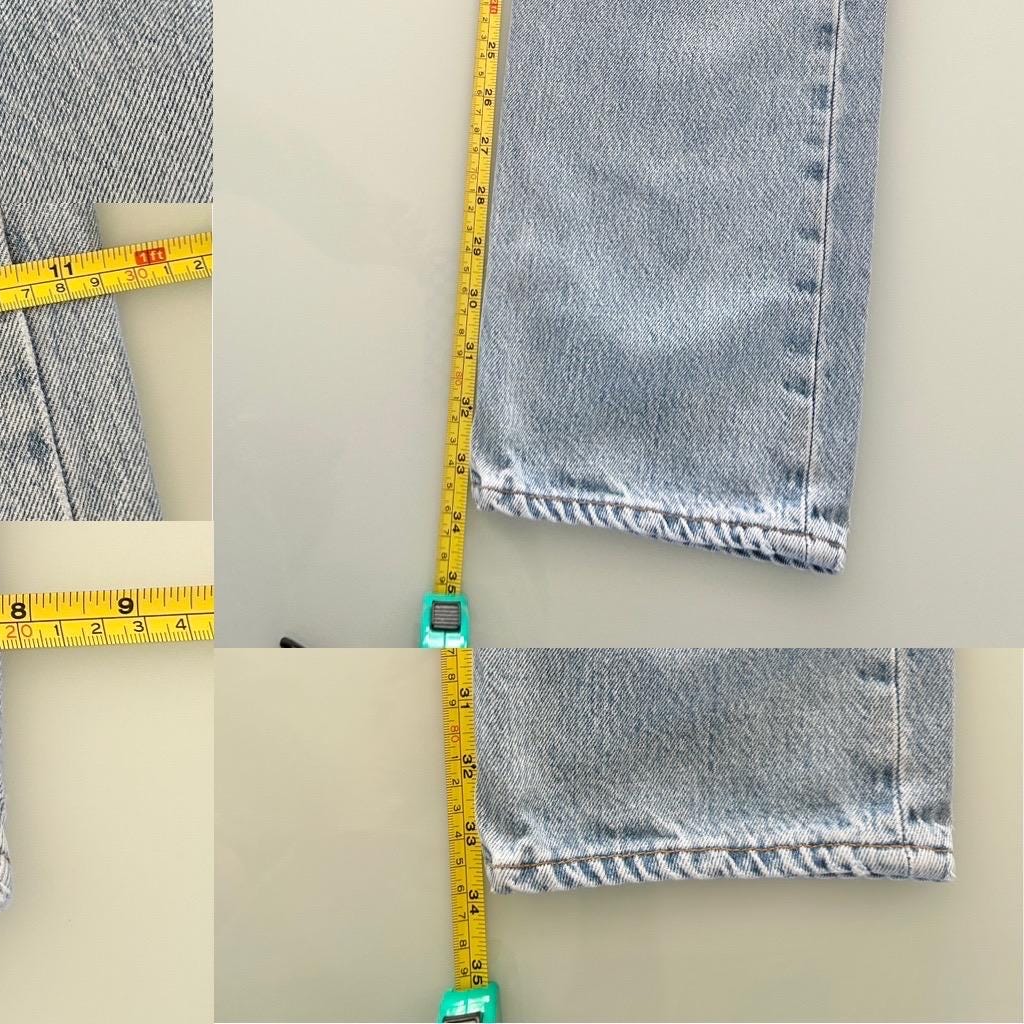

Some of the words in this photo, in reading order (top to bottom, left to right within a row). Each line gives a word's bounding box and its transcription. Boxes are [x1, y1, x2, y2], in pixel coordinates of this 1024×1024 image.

[488, 42, 496, 59] 25
[484, 88, 492, 106] 26
[481, 137, 489, 155] 27
[477, 186, 485, 205] 28
[474, 237, 482, 256] 29
[49, 262, 74, 278] 11
[140, 250, 164, 263] 1ft
[21, 288, 30, 299] 7
[56, 283, 65, 293] 8
[90, 277, 100, 288] 9
[126, 268, 148, 282] 30
[194, 260, 203, 270] 2
[469, 288, 478, 309] 30
[466, 342, 474, 360] 31
[461, 397, 470, 418] 32
[457, 453, 466, 475] 33
[452, 511, 462, 533] 34
[448, 571, 458, 595] 35
[10, 602, 27, 619] 8
[118, 597, 134, 614] 9
[5, 624, 33, 639] 20
[91, 622, 102, 635] 2
[133, 621, 144, 632] 3
[176, 618, 187, 630] 4
[460, 688, 470, 708] 31
[450, 725, 460, 743] 80
[462, 754, 473, 779] 32
[466, 822, 477, 846] 33
[469, 890, 480, 915] 34
[472, 960, 483, 985] 35
